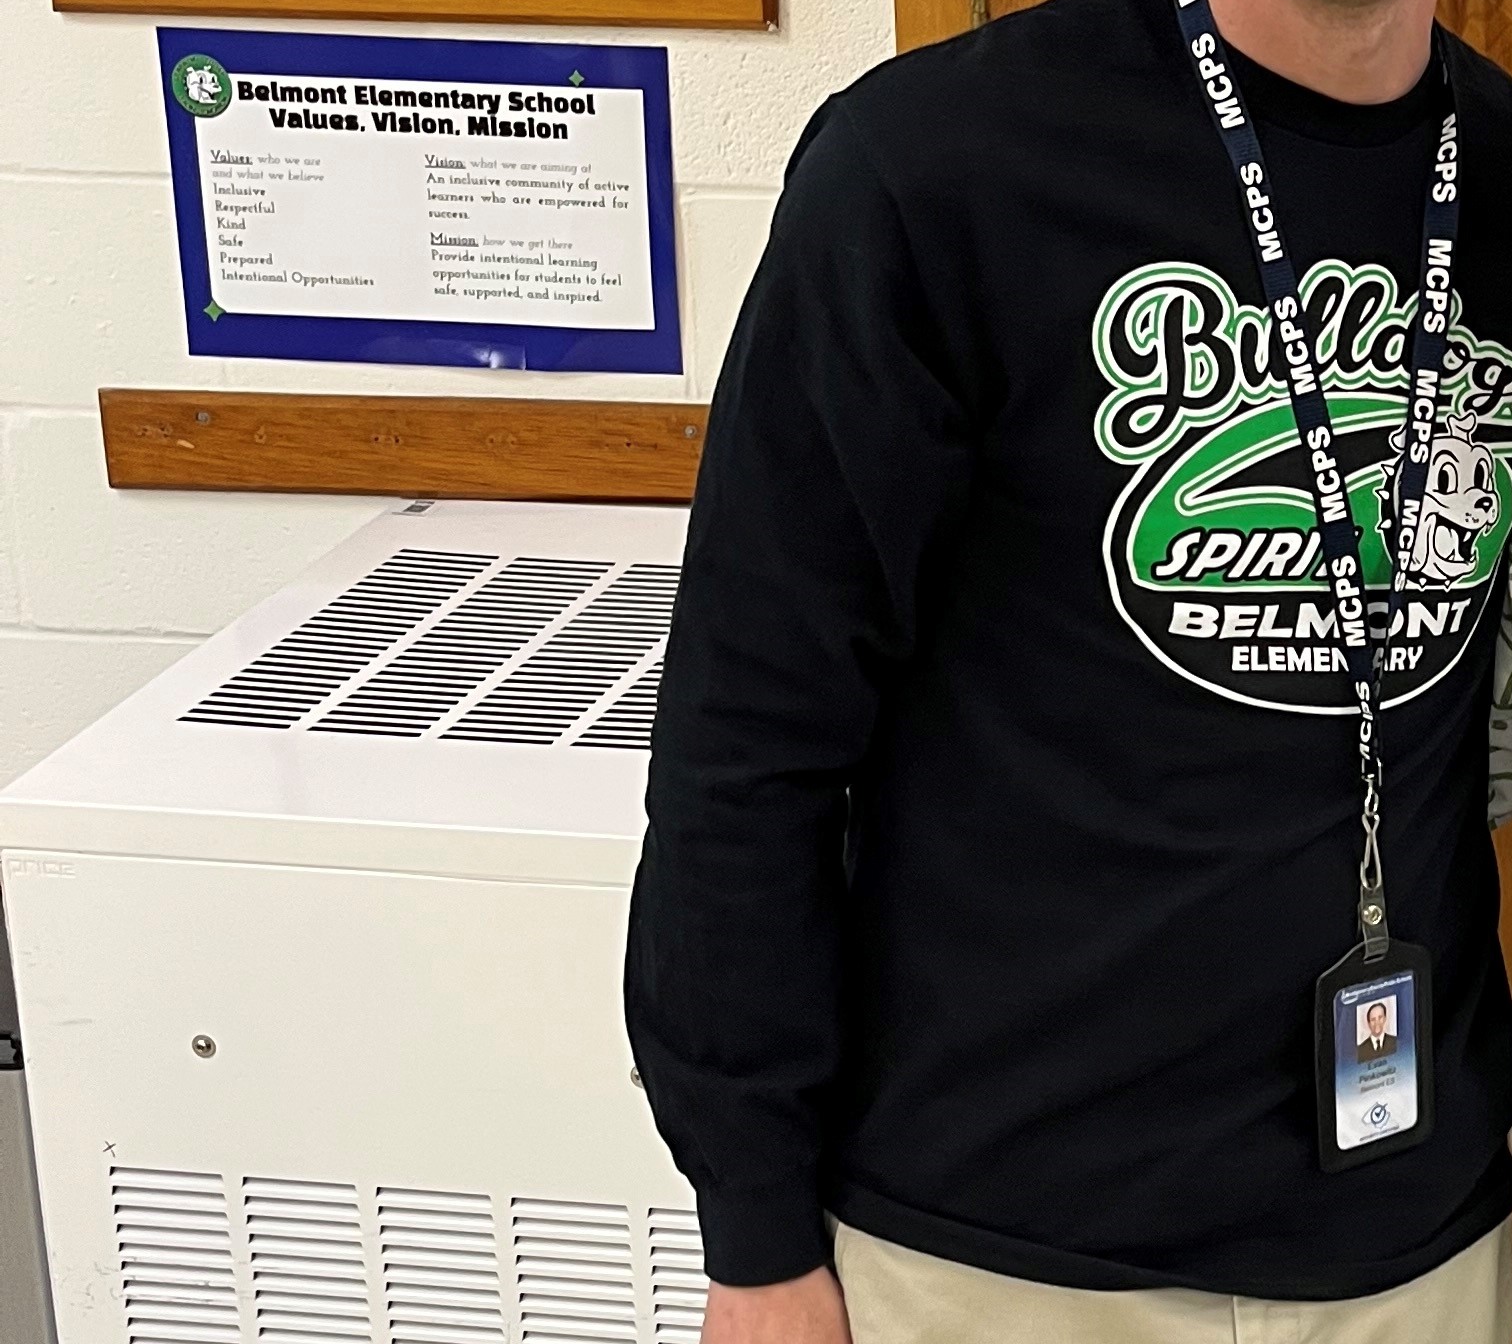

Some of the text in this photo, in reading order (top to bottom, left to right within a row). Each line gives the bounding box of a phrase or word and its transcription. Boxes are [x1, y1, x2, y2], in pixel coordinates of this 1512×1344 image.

[1191, 33, 1245, 129] MCPS
[237, 81, 596, 115] Belmont Elementary School
[467, 116, 568, 140] Mission
[258, 153, 281, 165] who
[285, 157, 300, 166] we
[470, 158, 497, 169] what
[501, 162, 516, 170] we
[520, 162, 537, 171] are
[541, 162, 577, 175] aiming
[581, 163, 592, 174] at
[1431, 113, 1458, 203] MCPS
[268, 171, 284, 180] we
[288, 169, 324, 182] believe
[426, 173, 630, 192] An inclusive community of active
[213, 183, 266, 196] Inclusive
[427, 188, 629, 210] learners who are empowered for
[215, 200, 275, 215] Respectful
[1240, 162, 1283, 263] MCPS
[216, 217, 246, 230] Kind
[218, 234, 244, 247] Safe
[482, 235, 505, 246] how
[509, 238, 524, 247] we
[528, 238, 544, 251] get
[548, 238, 573, 250] there
[220, 251, 273, 267] Prepared
[431, 249, 598, 271] Provide intentional learning
[221, 269, 374, 287] Intentional Opportunities
[433, 269, 622, 286] opportunities for students to feel
[1421, 238, 1452, 334] MCPS
[527, 288, 549, 300] and
[1274, 295, 1319, 396] MCPS
[1410, 369, 1438, 464] MCPS
[1306, 425, 1347, 523] MCPS
[1154, 529, 1340, 579] SPIRI
[1331, 555, 1366, 646] MCPS
[1232, 645, 1424, 672] ELEMENARY
